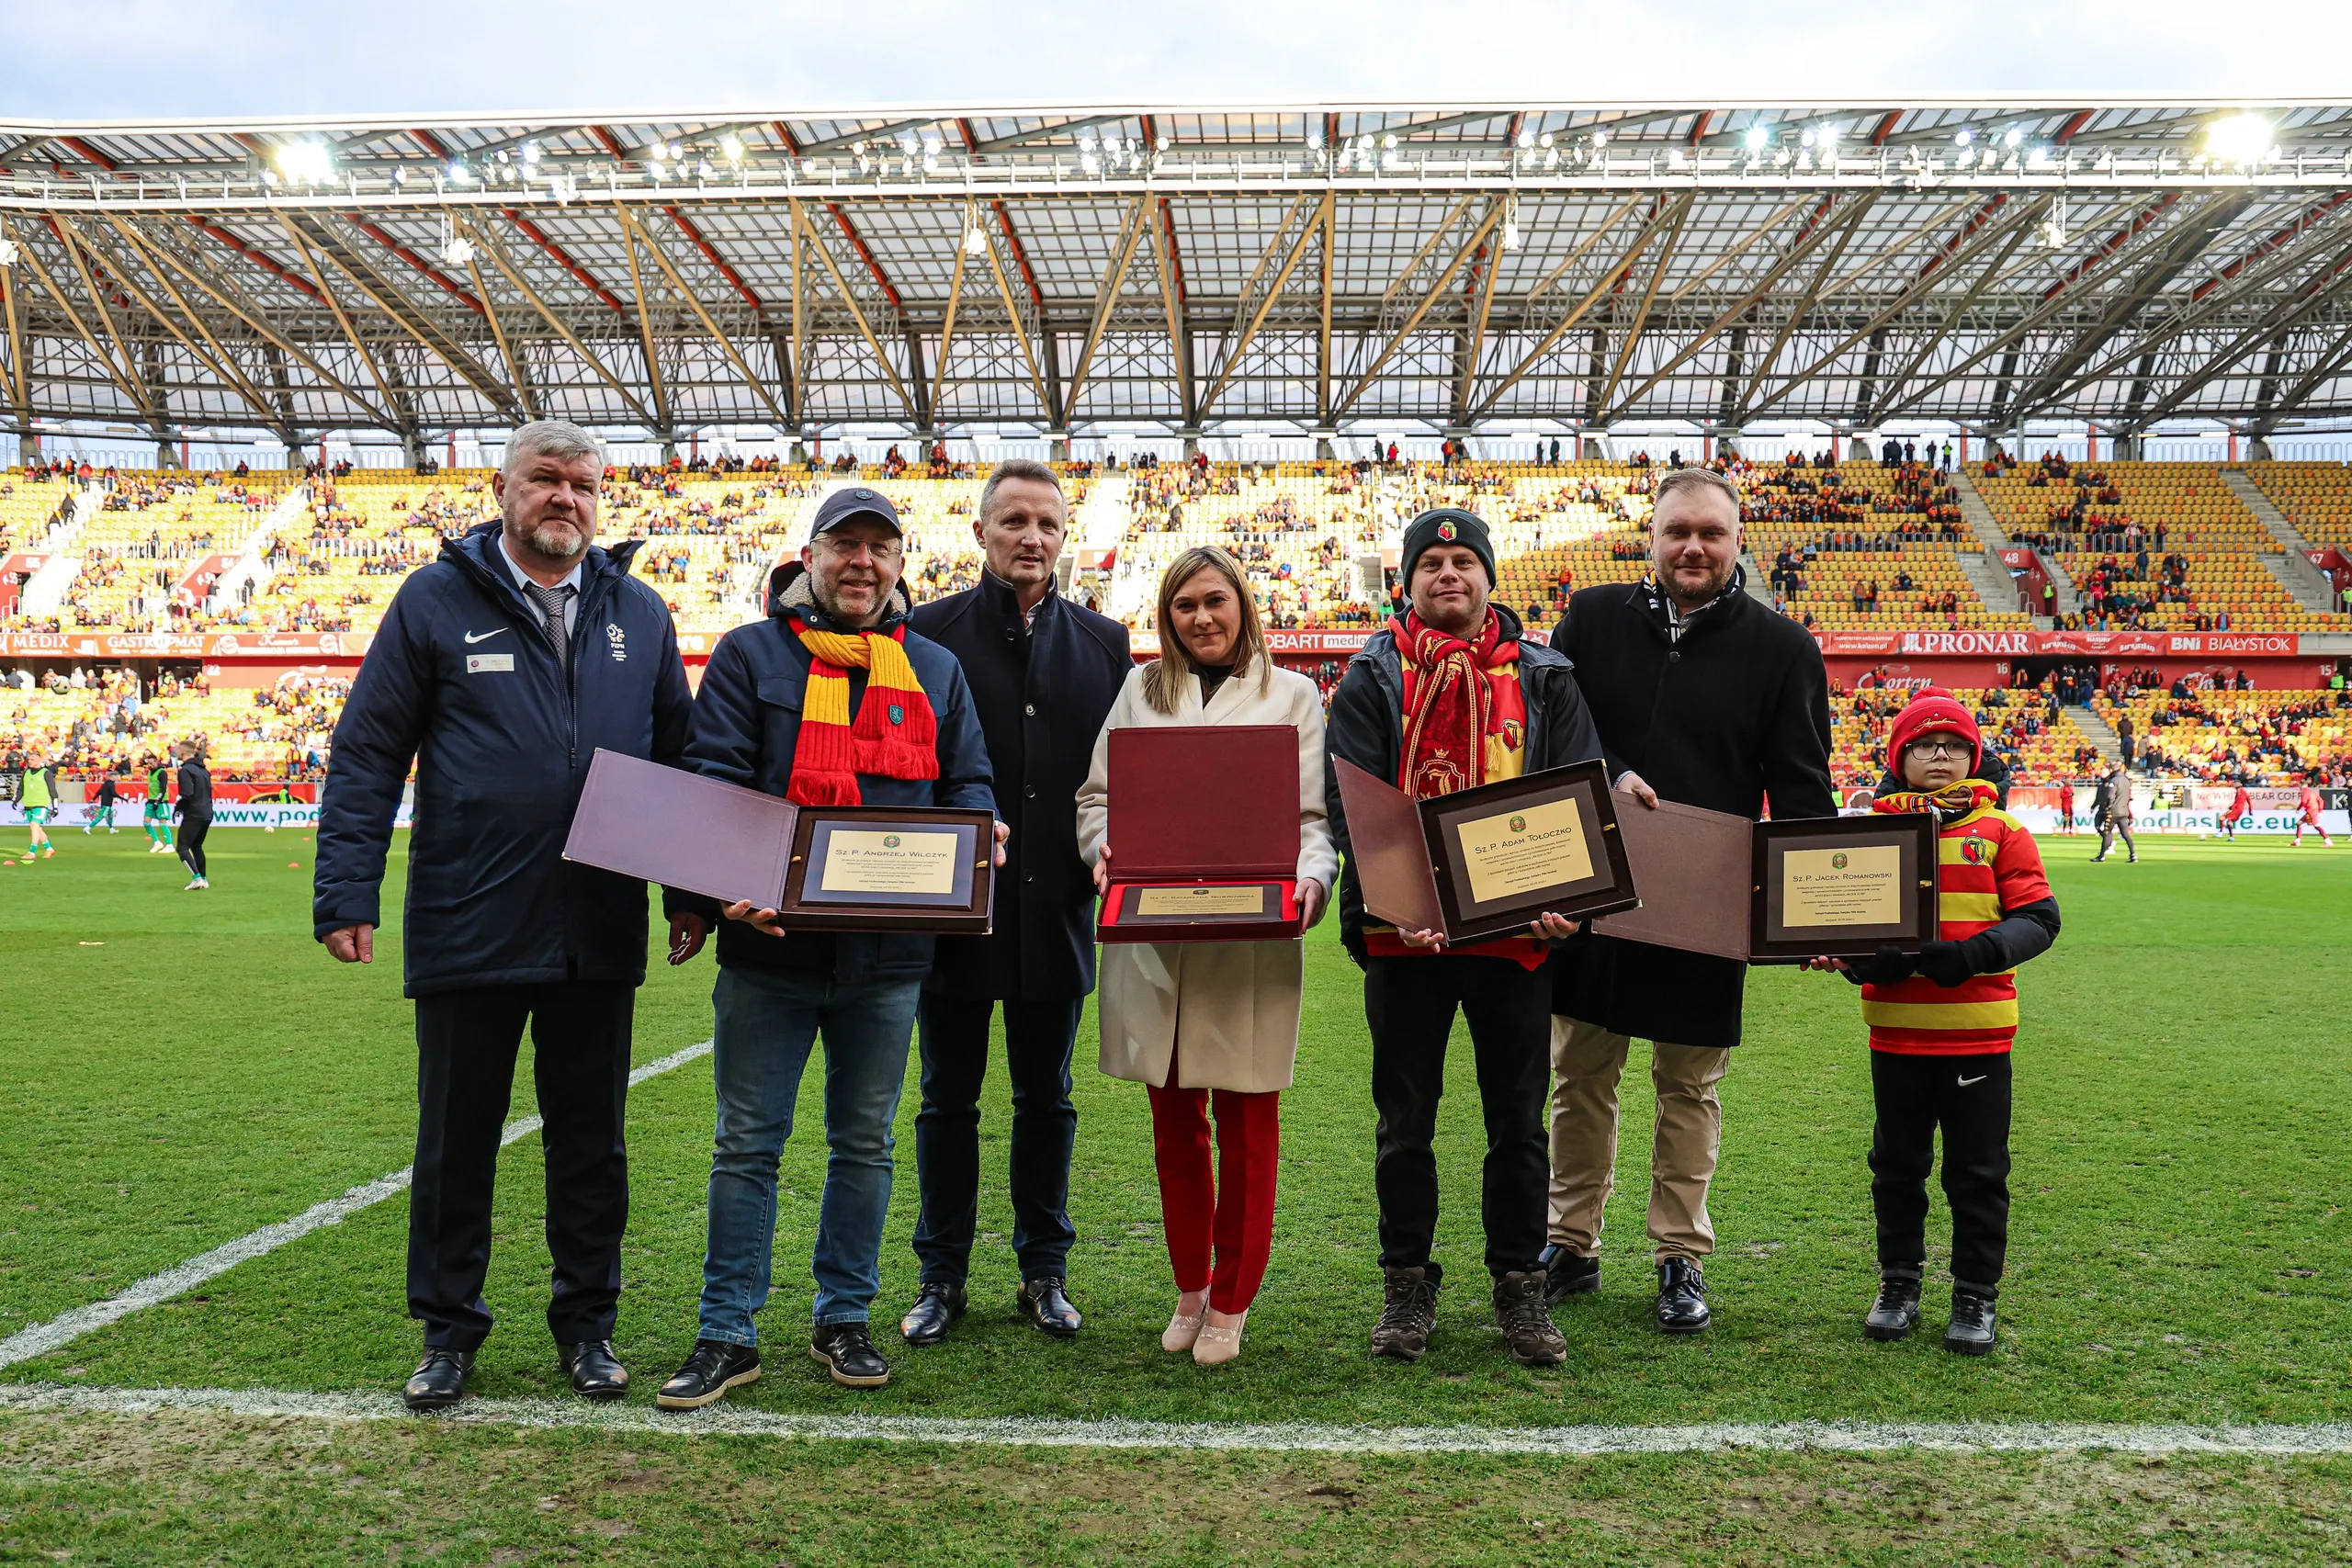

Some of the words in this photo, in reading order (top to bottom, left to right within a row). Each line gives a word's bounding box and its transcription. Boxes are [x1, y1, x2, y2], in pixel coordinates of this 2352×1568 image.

[2004, 552, 2019, 564] 48
[2310, 553, 2324, 564] 47
[13, 636, 70, 649] MEDIX
[1263, 634, 1322, 649] OBART
[1924, 633, 2030, 653] PRONAR
[2208, 637, 2290, 651] BIAŁYSTOK
[1996, 662, 2008, 675] 16
[2319, 665, 2332, 676] 15
[2250, 792, 2276, 800] BEAR
[2278, 792, 2302, 800] COFF
